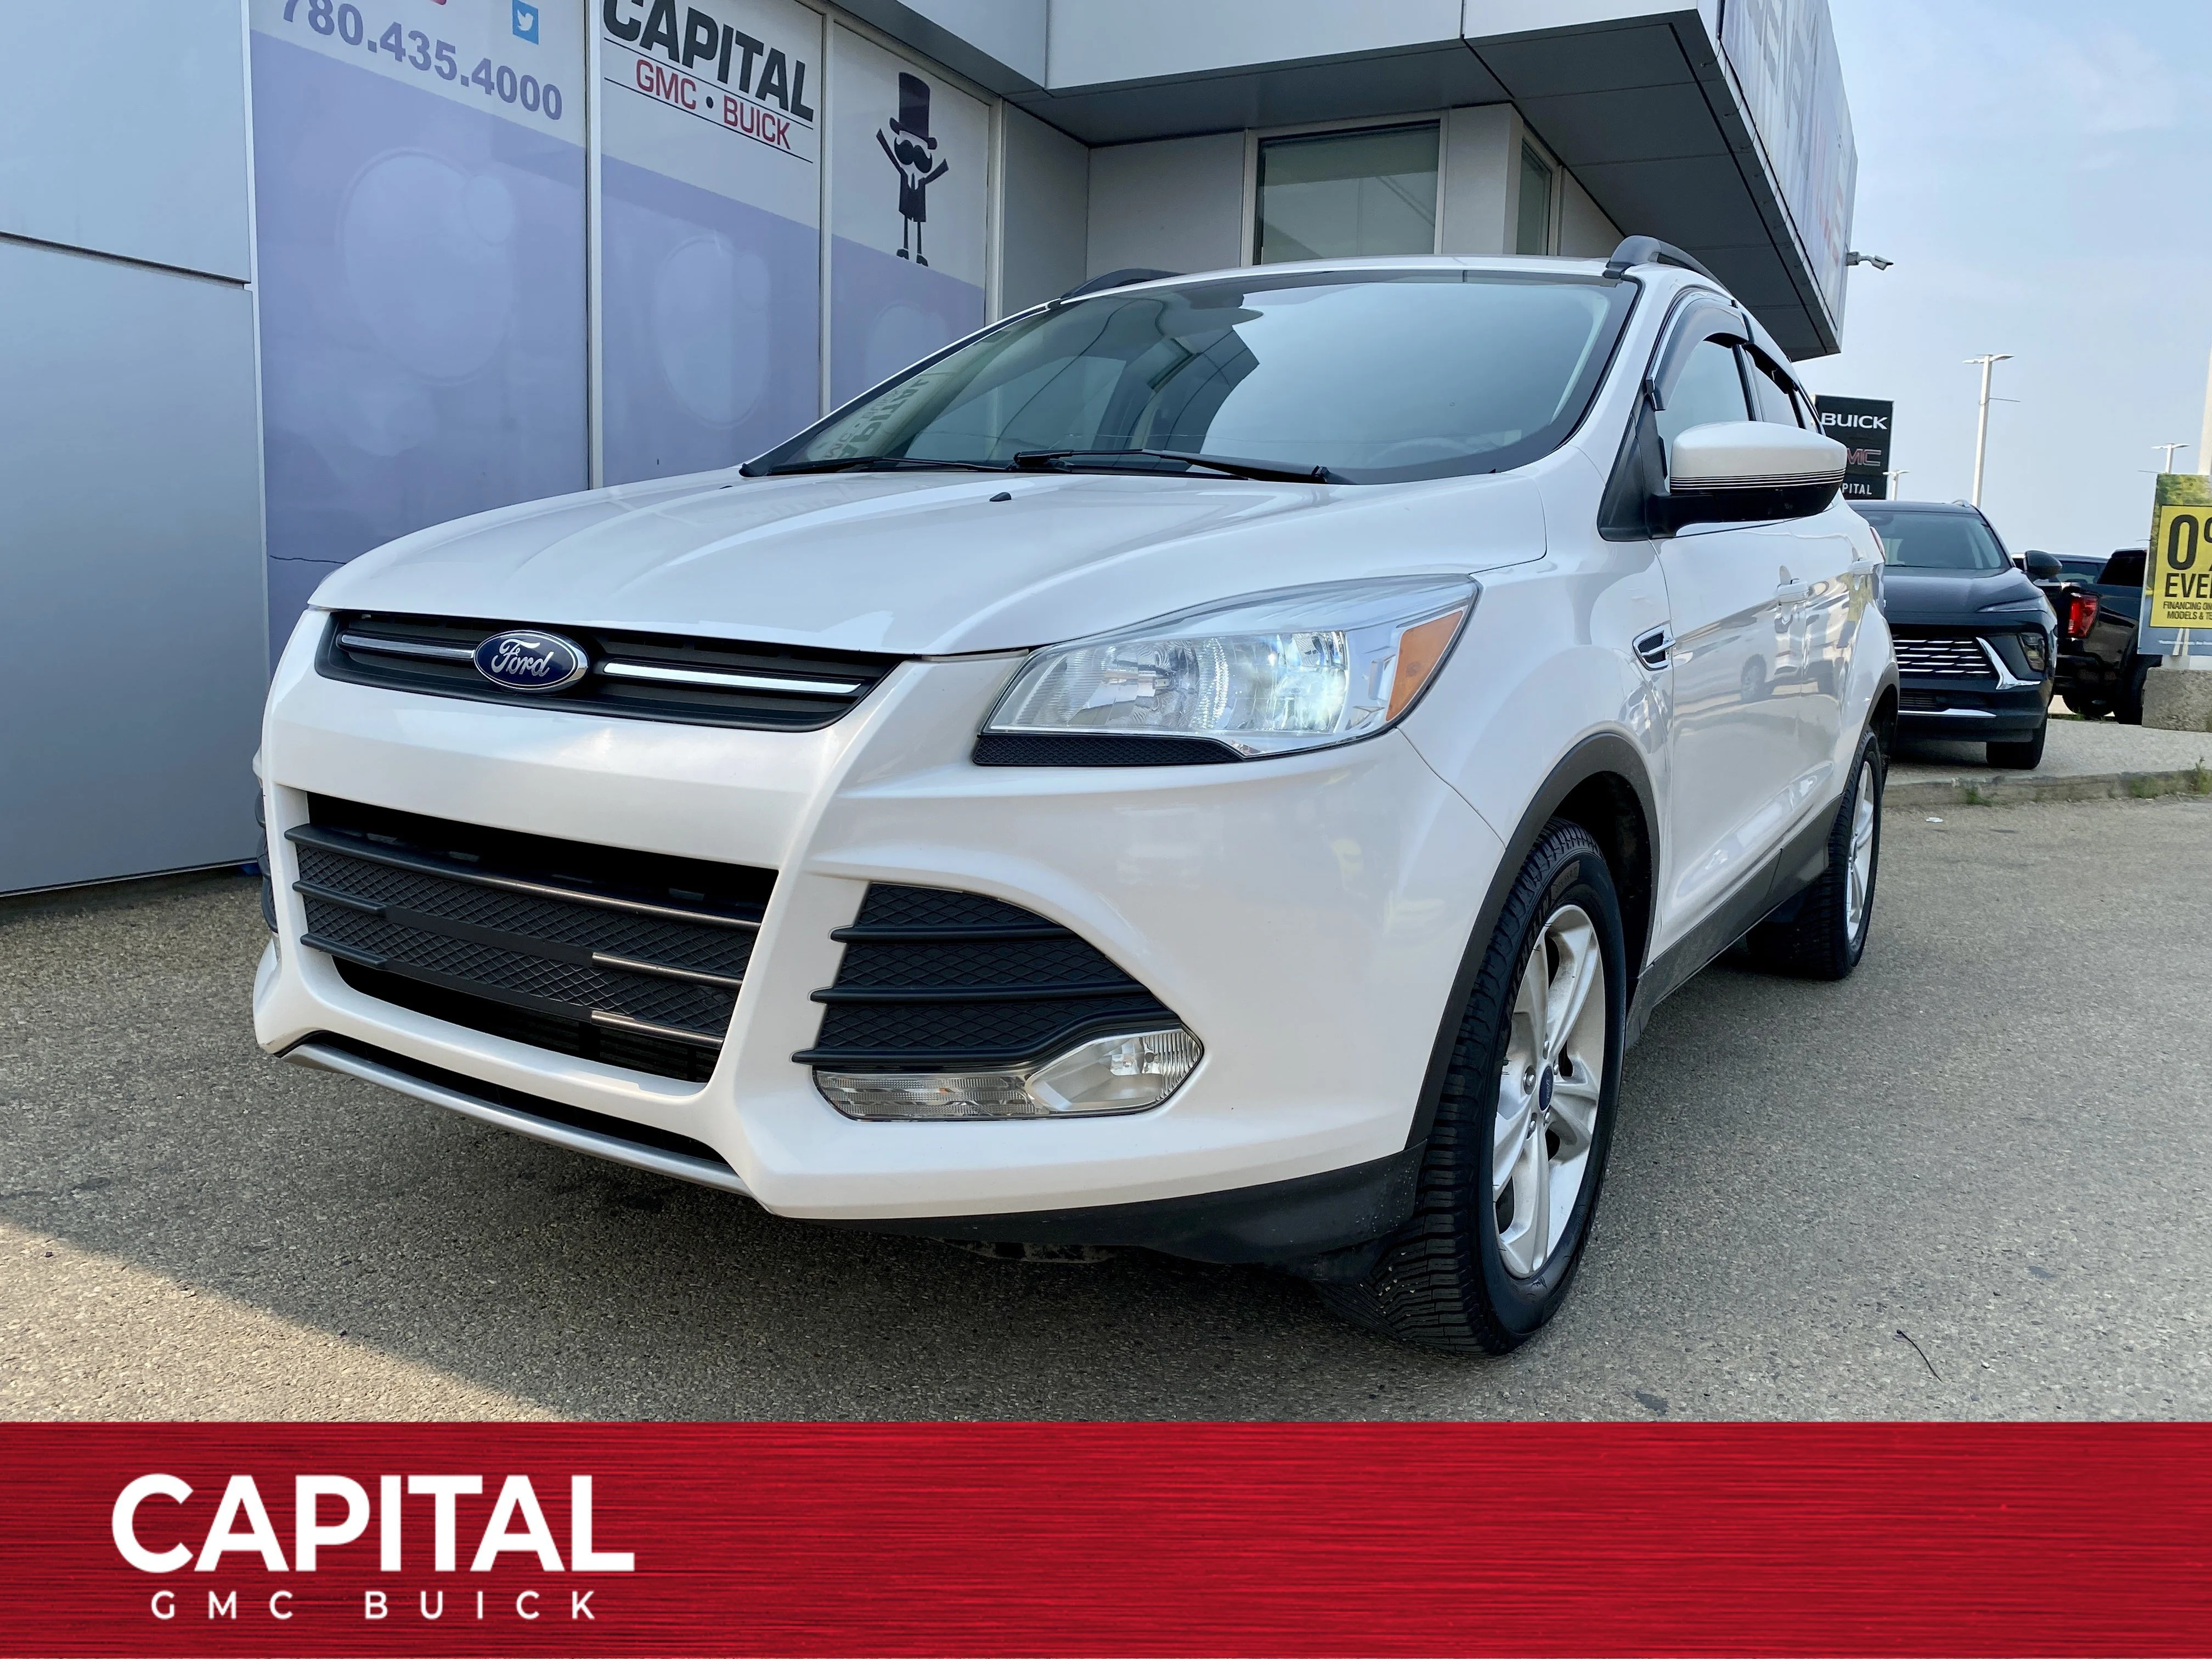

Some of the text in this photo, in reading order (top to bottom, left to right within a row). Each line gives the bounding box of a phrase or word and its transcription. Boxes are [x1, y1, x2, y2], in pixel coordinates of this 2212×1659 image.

[604, 0, 814, 122] CAPITAL
[636, 59, 791, 150] GMC BUICK
[1821, 413, 1888, 430] BUICK
[1847, 448, 1881, 466] MC
[1842, 483, 1872, 495] PITAL
[2165, 573, 2212, 599] EVE
[2163, 601, 2201, 610] FINANCING
[2167, 611, 2198, 620] MODELS
[2198, 611, 2204, 620] &
[491, 639, 554, 677] Ford
